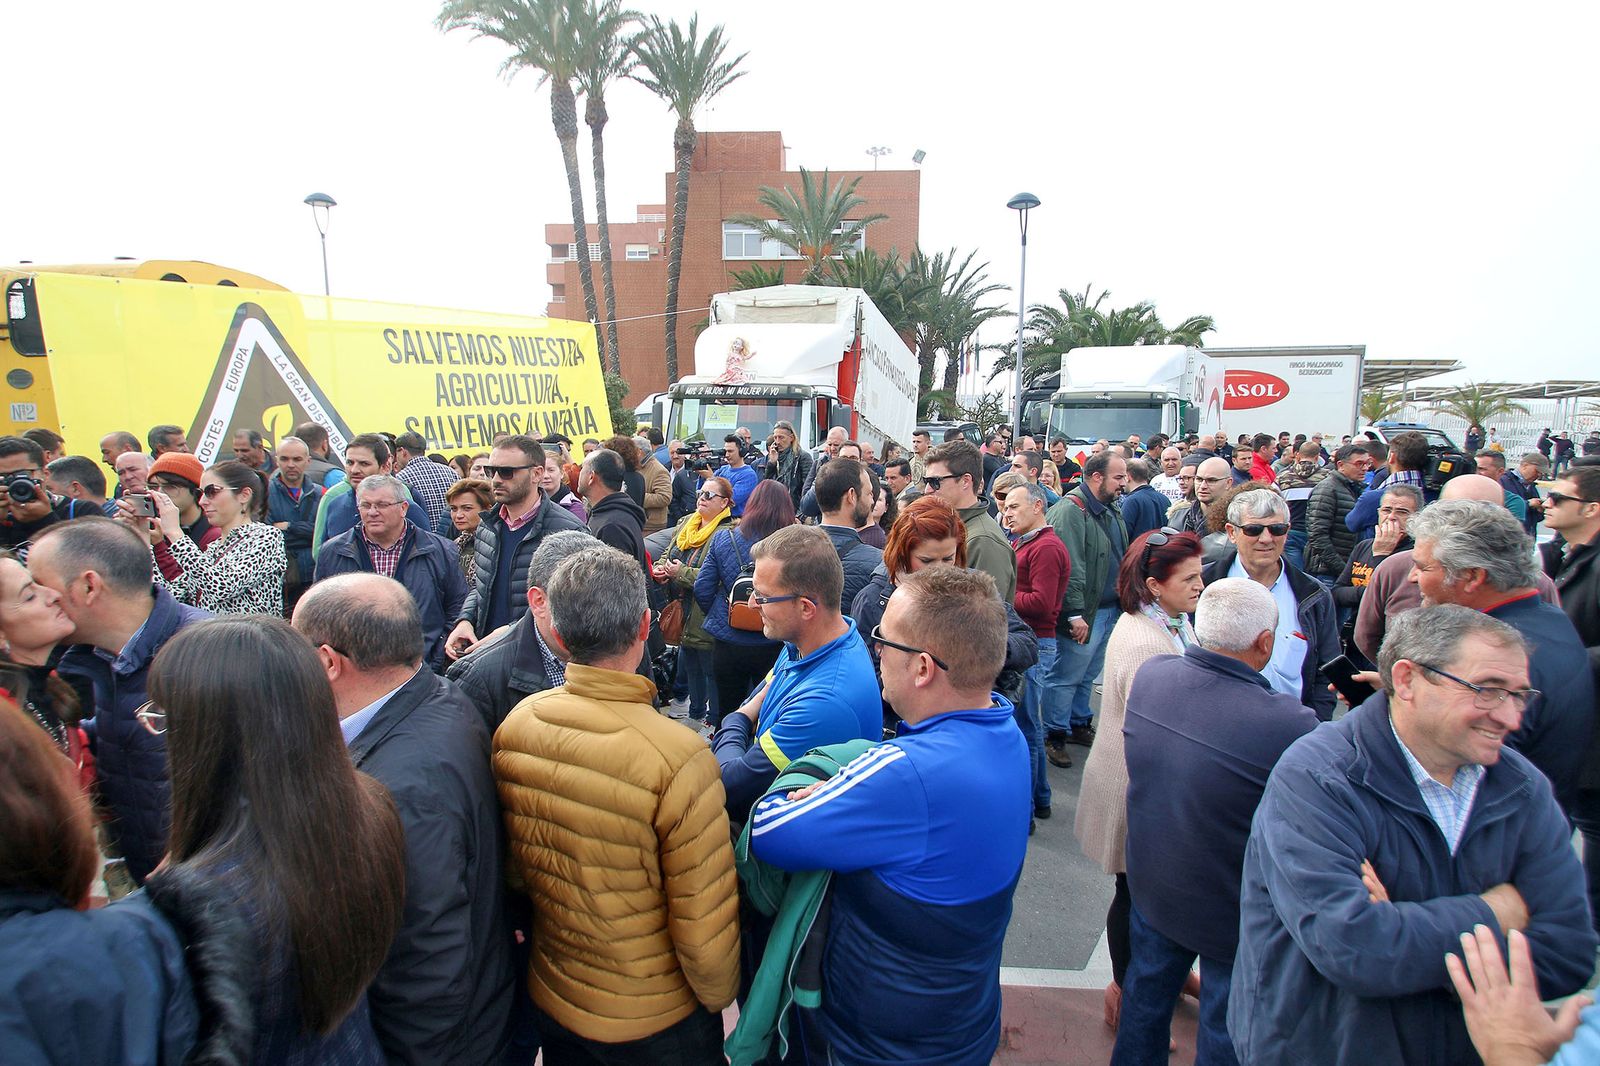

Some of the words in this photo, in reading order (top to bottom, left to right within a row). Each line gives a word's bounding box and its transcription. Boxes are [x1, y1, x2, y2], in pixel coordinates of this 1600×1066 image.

[383, 328, 507, 366] SALVEMOS
[508, 335, 585, 367] NUESTRA
[225, 347, 249, 392] EUROPA
[273, 354, 288, 370] LA
[286, 371, 311, 402] GRAN
[436, 373, 569, 408] AGRICULTURA,
[685, 386, 696, 395] MIS
[698, 386, 703, 395] 2
[726, 386, 735, 395] MI
[737, 386, 761, 395] MUJER
[761, 386, 767, 395] Y
[769, 387, 780, 395] YO
[1224, 383, 1281, 398] ASOL
[198, 418, 224, 463] COSTES
